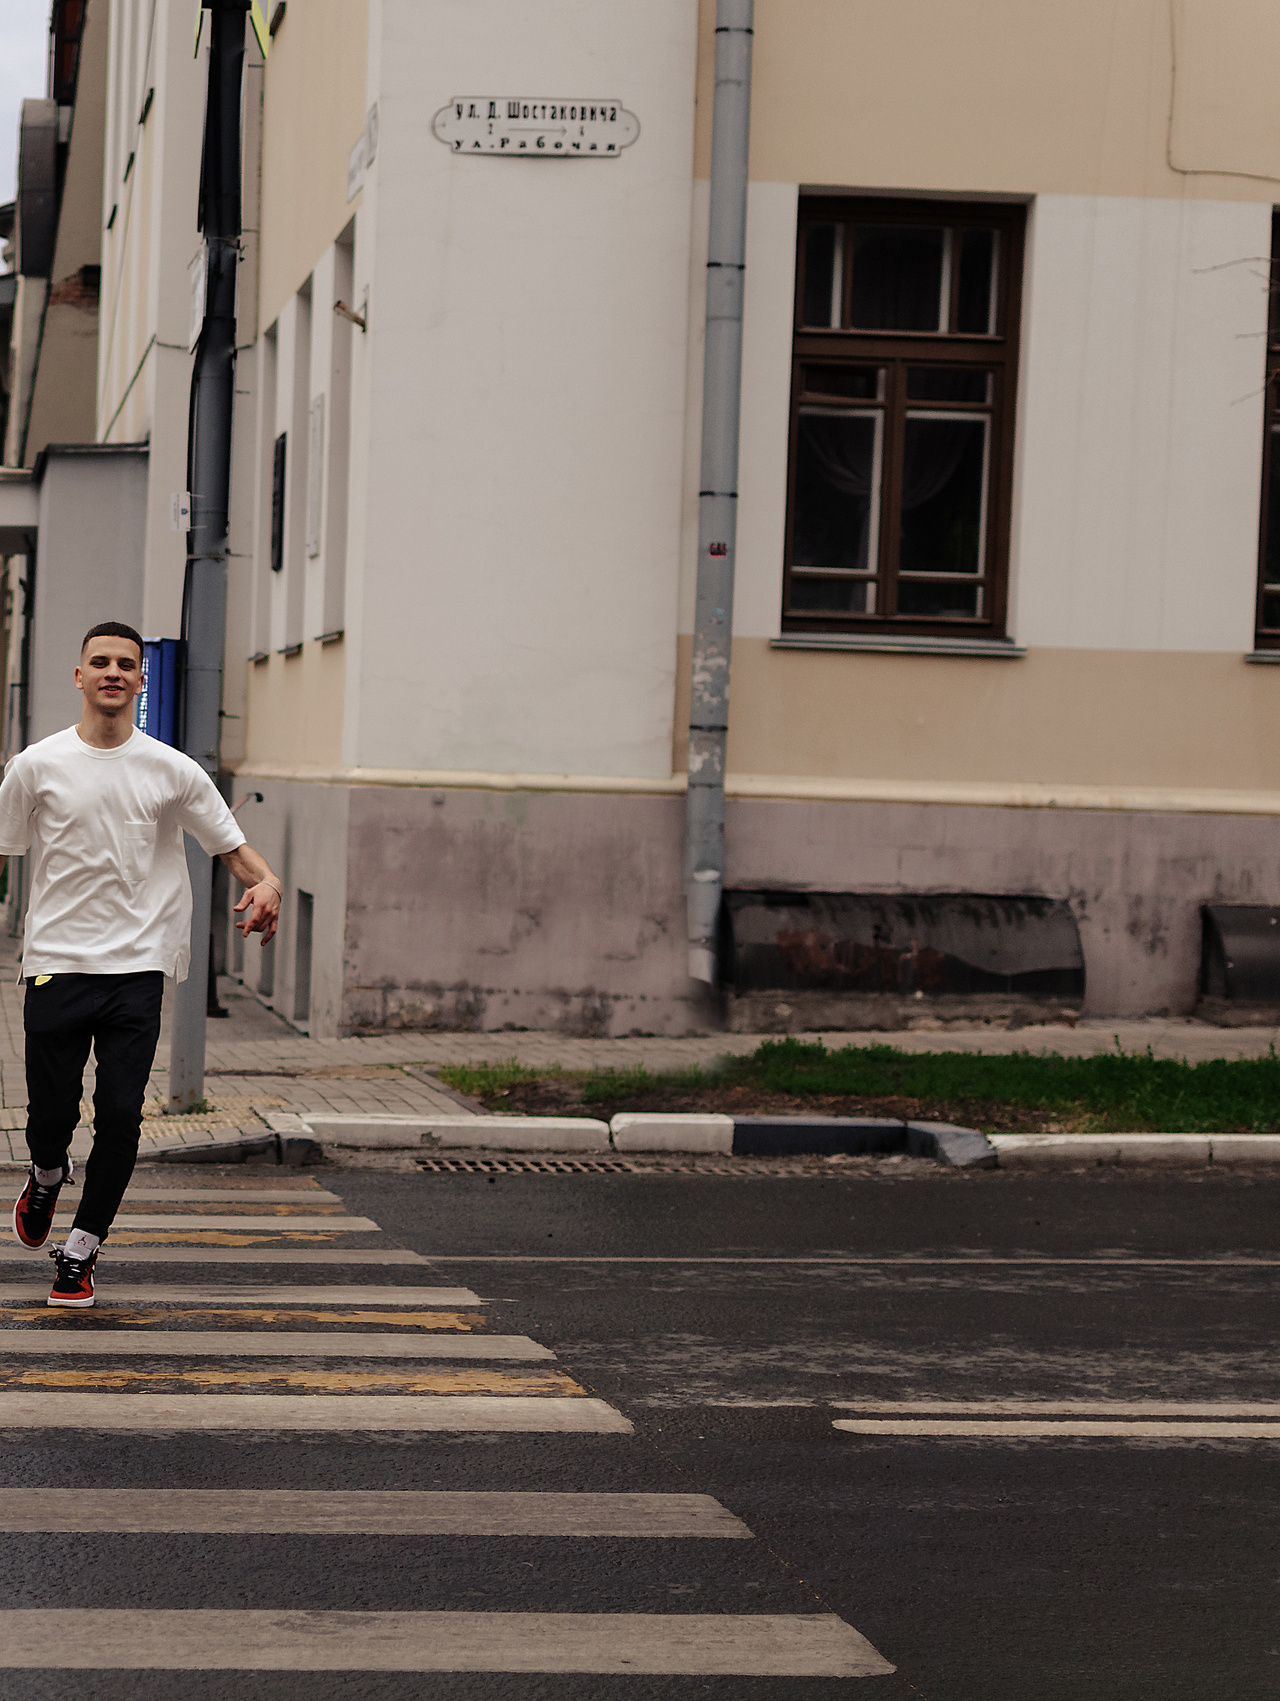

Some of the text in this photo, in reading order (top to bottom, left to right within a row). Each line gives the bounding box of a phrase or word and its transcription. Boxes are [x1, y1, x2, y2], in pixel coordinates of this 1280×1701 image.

[455, 101, 616, 121] ул. Д. Шостаковича
